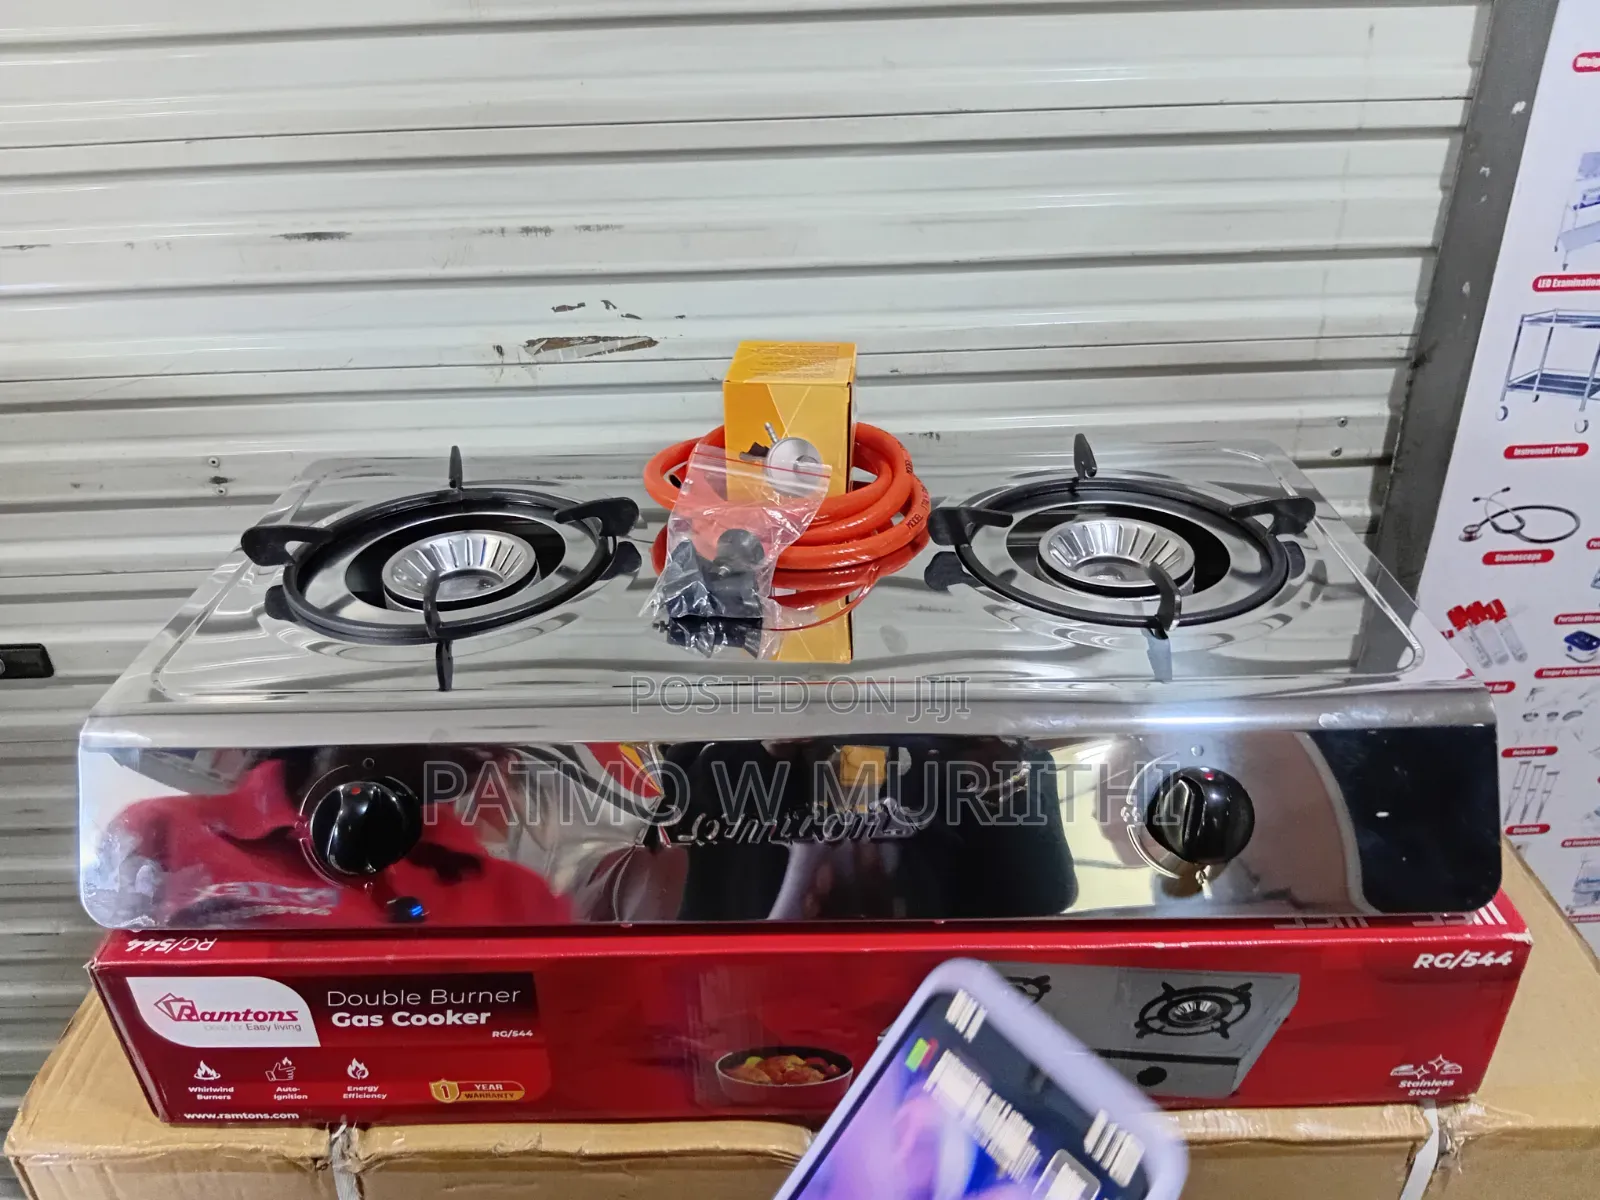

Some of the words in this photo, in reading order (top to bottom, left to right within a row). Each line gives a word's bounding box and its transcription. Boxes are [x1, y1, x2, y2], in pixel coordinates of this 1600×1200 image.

[125, 937, 218, 954] RG/544
[1413, 949, 1513, 970] RG/544
[327, 989, 421, 1007] Double
[430, 988, 521, 1005] Burner
[173, 1001, 299, 1022] Ramtons
[331, 1012, 384, 1027] Gas
[391, 1009, 492, 1027] Cooker
[246, 1023, 271, 1033] Easy
[274, 1023, 302, 1032] living
[492, 1030, 534, 1039] RG/544
[474, 1083, 504, 1091] YEAR
[1398, 1079, 1454, 1088] Stainless
[347, 1085, 379, 1093] Energy
[1408, 1088, 1441, 1097] Steel
[273, 1093, 308, 1101] Ignition
[342, 1092, 388, 1100] Efficiency
[184, 1112, 300, 1120] www.ramtons.com
